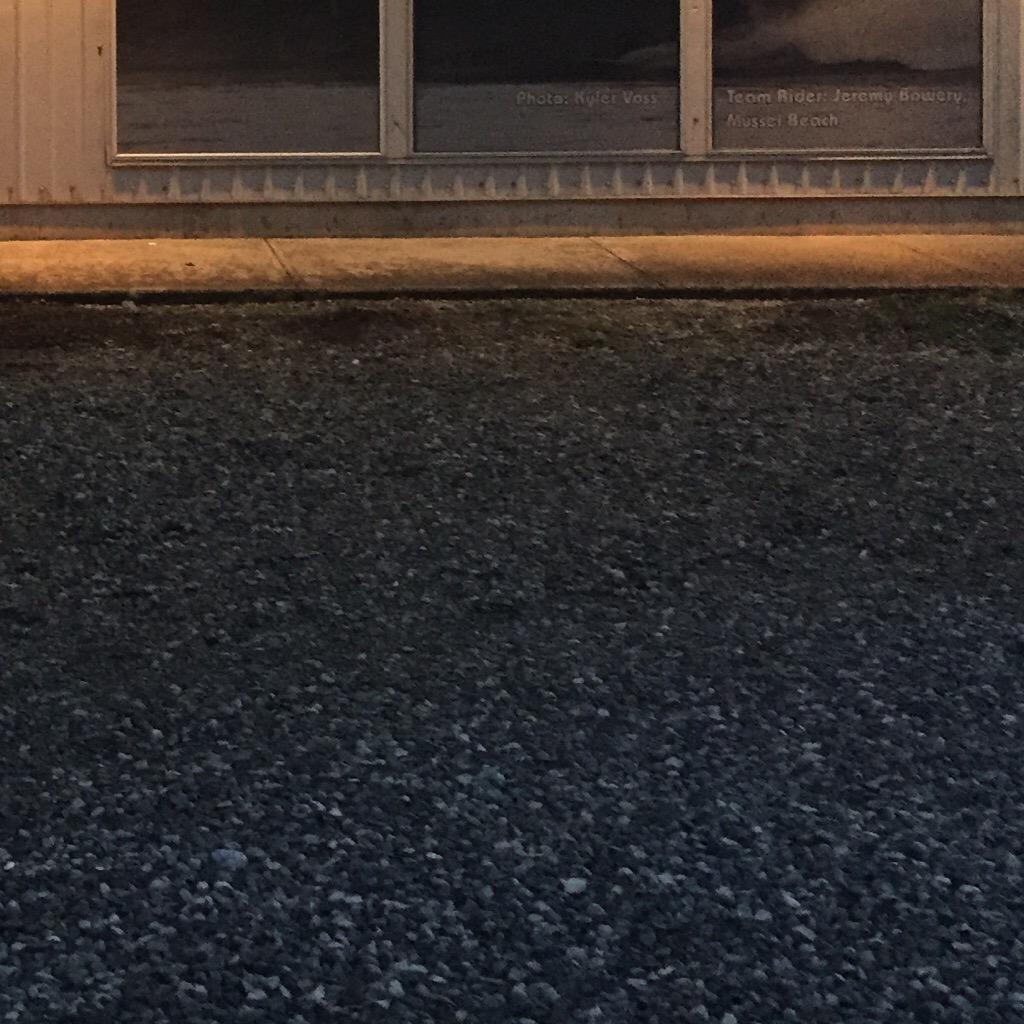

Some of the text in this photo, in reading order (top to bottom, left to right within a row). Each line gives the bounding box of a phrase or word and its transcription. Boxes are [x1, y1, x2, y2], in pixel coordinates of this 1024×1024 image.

[516, 91, 568, 105] Photo:
[622, 90, 658, 105] Voss
[727, 89, 772, 104] Team
[777, 88, 827, 104] Rider:
[832, 88, 893, 106] Jeremy
[787, 113, 839, 128] Beach
